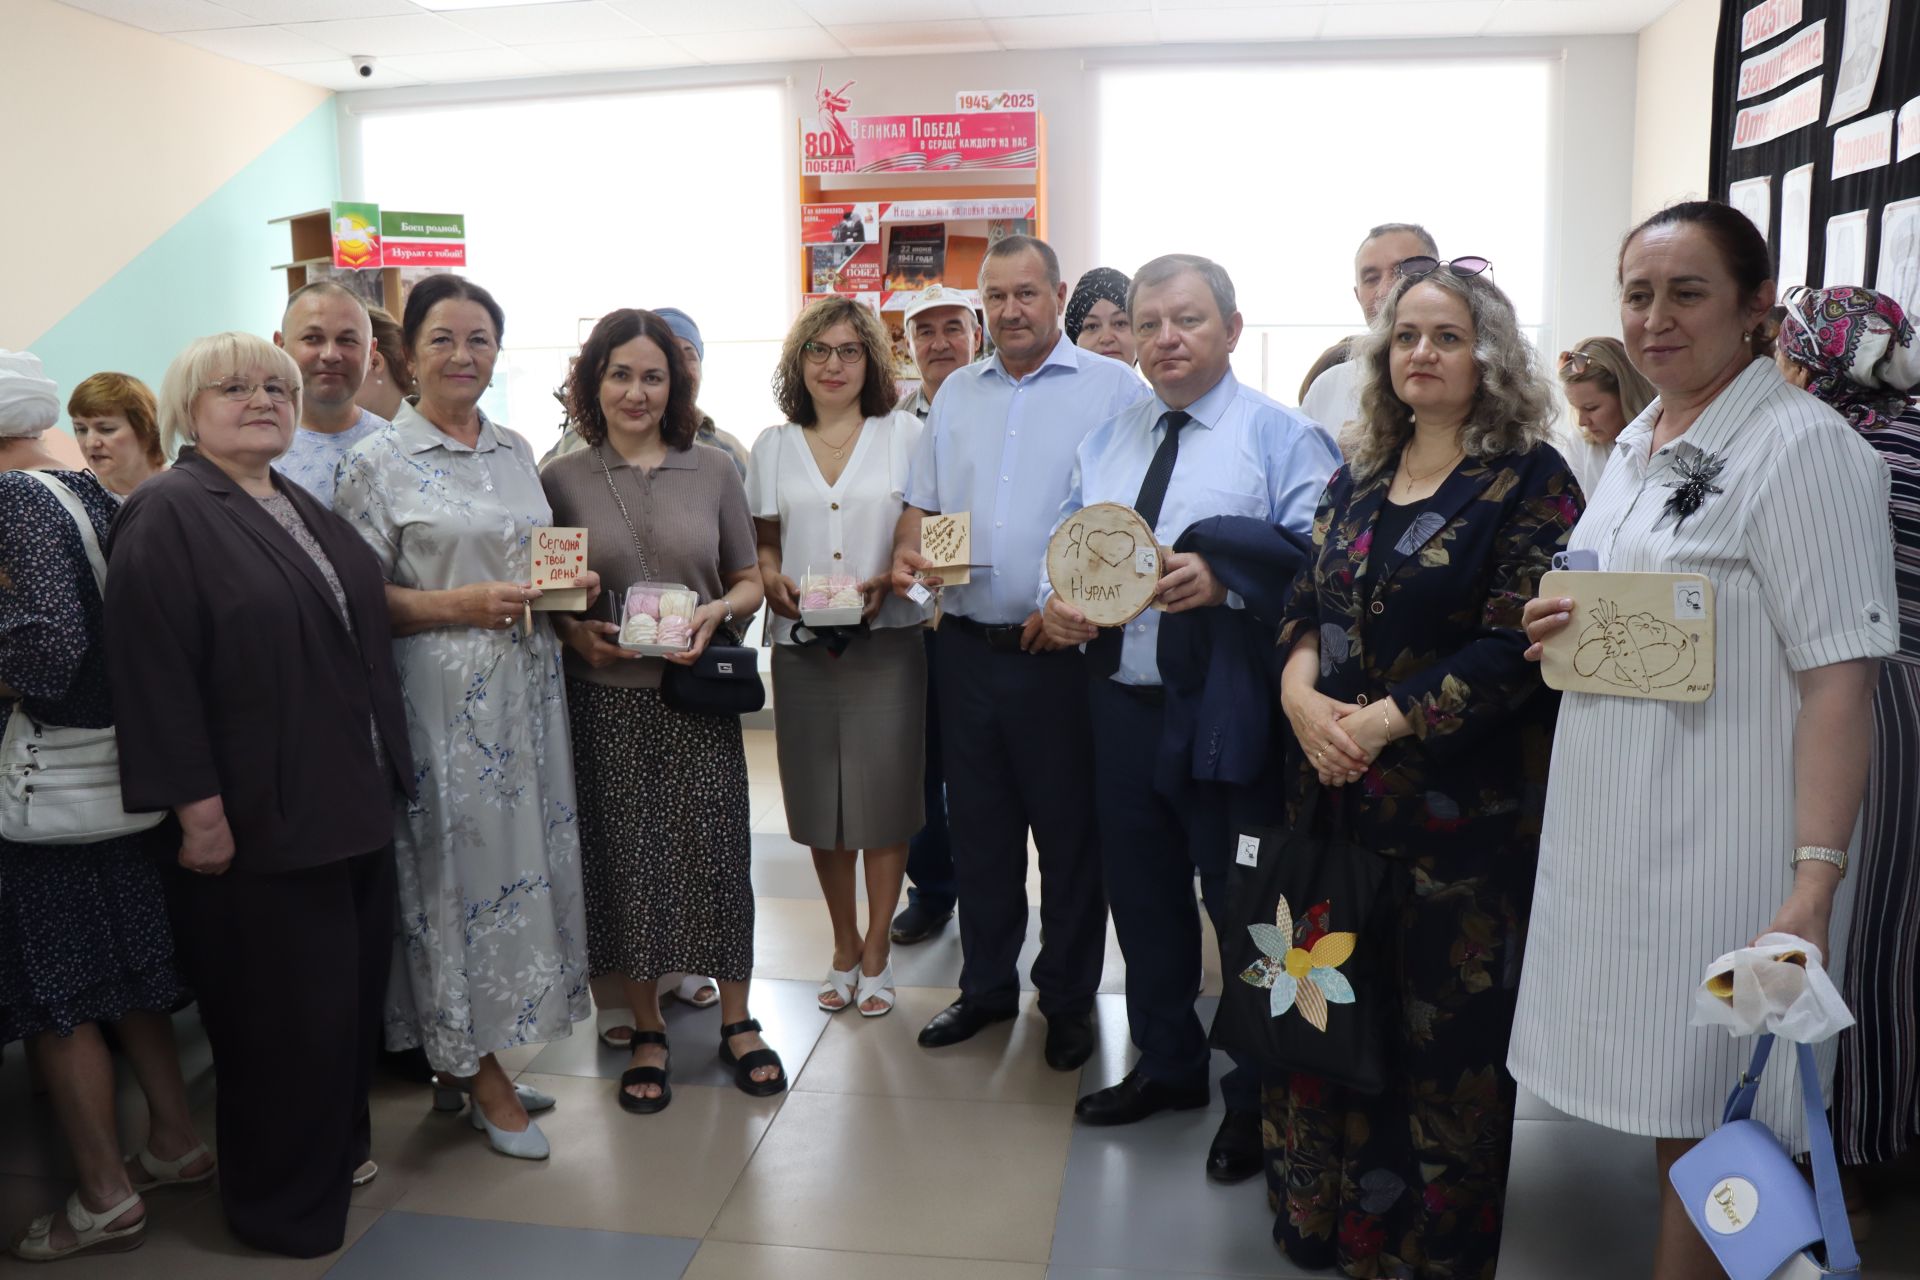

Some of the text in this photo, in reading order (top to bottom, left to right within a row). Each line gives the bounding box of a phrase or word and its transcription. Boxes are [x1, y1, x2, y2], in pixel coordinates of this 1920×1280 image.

[959, 94, 1035, 110] 1945 2025
[805, 131, 834, 157] 80
[928, 139, 957, 150] СЕРДЦЕ
[959, 138, 997, 149] КАЖДОГО
[1012, 137, 1028, 147] НАС
[805, 159, 856, 174] ПОБЕДА!
[401, 222, 461, 235] Боец родной,
[392, 248, 426, 260] Нурлат
[435, 248, 463, 258] тобой!
[898, 254, 934, 264] 1941 года
[539, 532, 580, 552] Сегодня
[1064, 523, 1084, 559] Я
